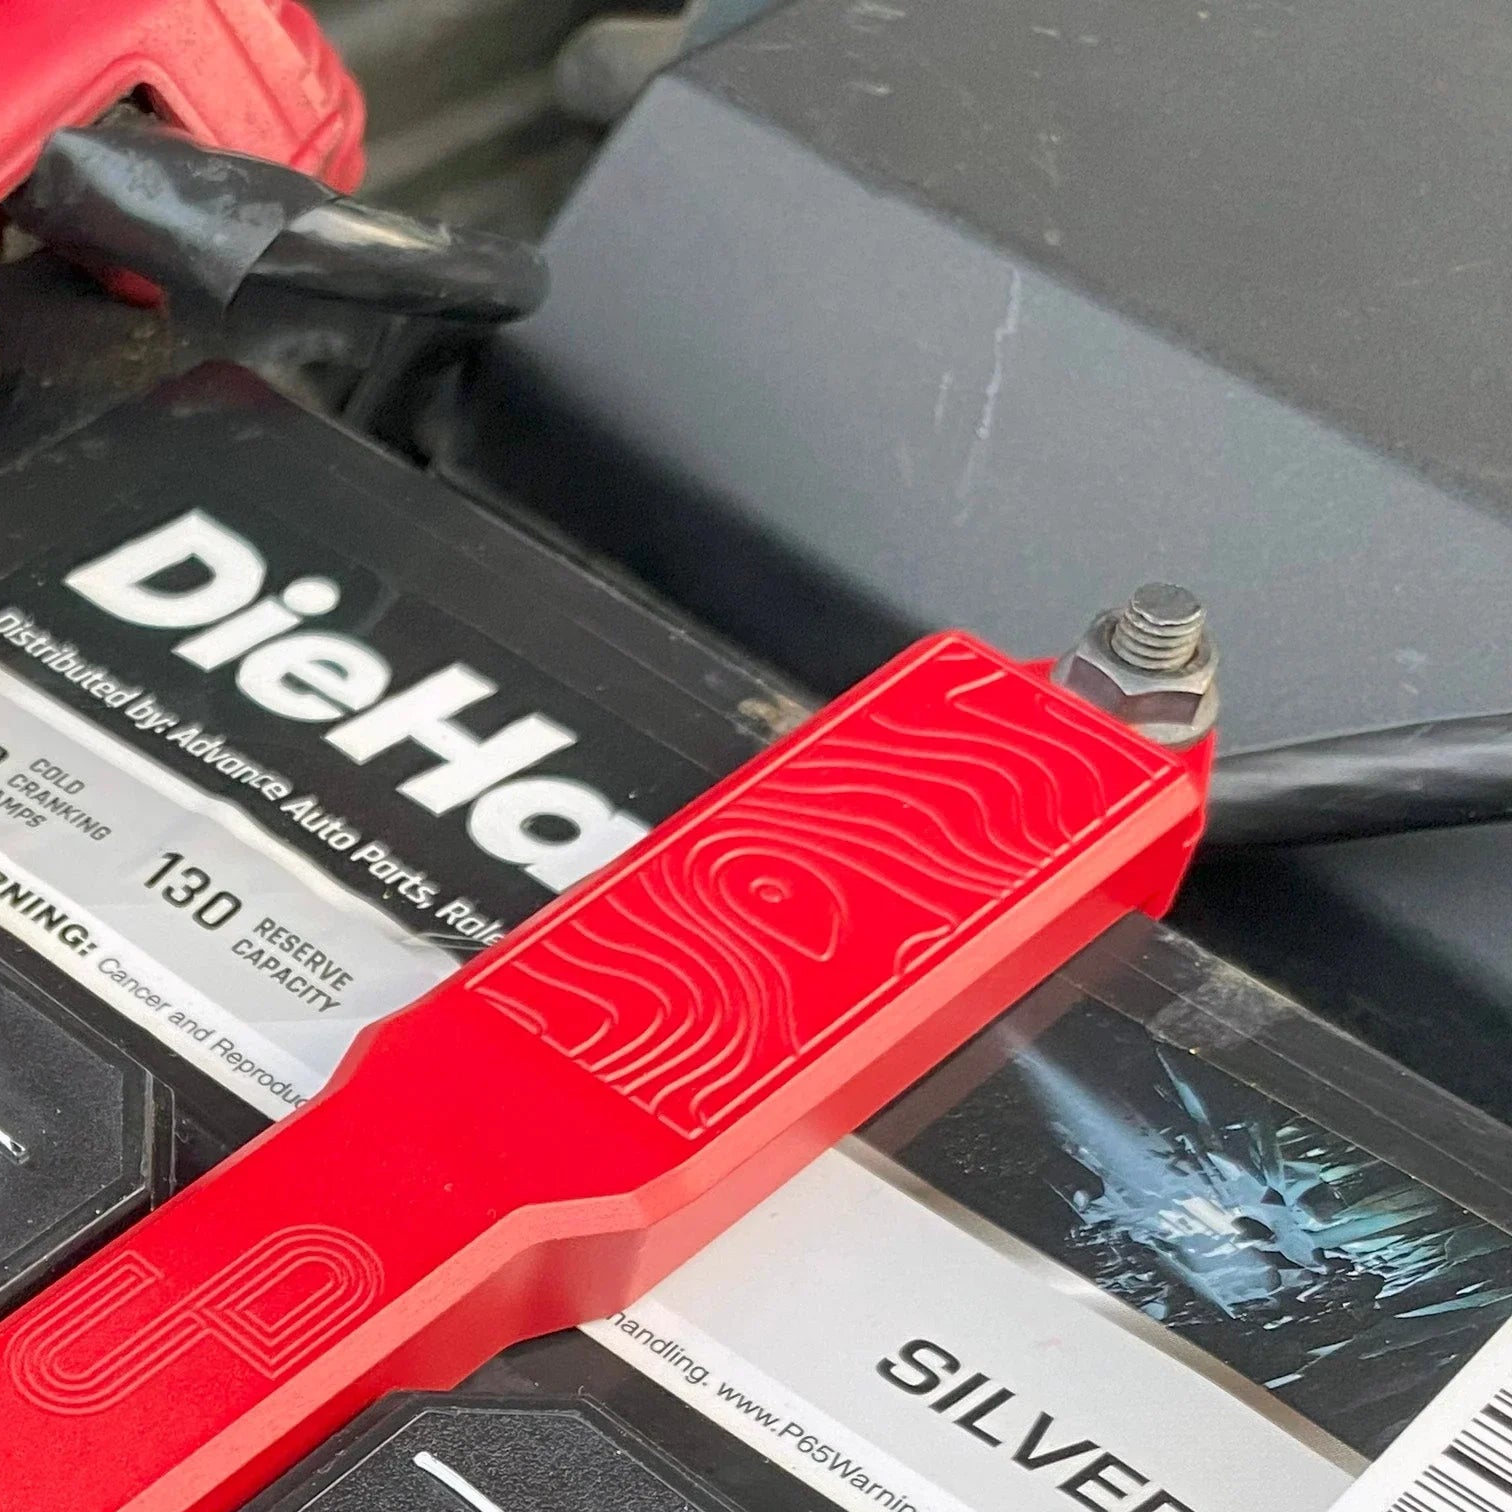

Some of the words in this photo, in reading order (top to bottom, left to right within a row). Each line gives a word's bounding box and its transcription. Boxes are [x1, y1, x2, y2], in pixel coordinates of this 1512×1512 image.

[62, 507, 653, 894] DieHa
[7, 773, 112, 842] CRANKING
[28, 758, 85, 796] COLD
[126, 692, 179, 735] by:
[167, 726, 294, 802] Advance
[280, 795, 360, 853] Auto
[349, 841, 441, 910] Parts,
[143, 851, 242, 931] 130
[232, 939, 341, 1014] CAPACITY
[253, 917, 354, 992] RESERVE
[97, 957, 171, 1012] Cancer
[167, 1010, 214, 1043] and
